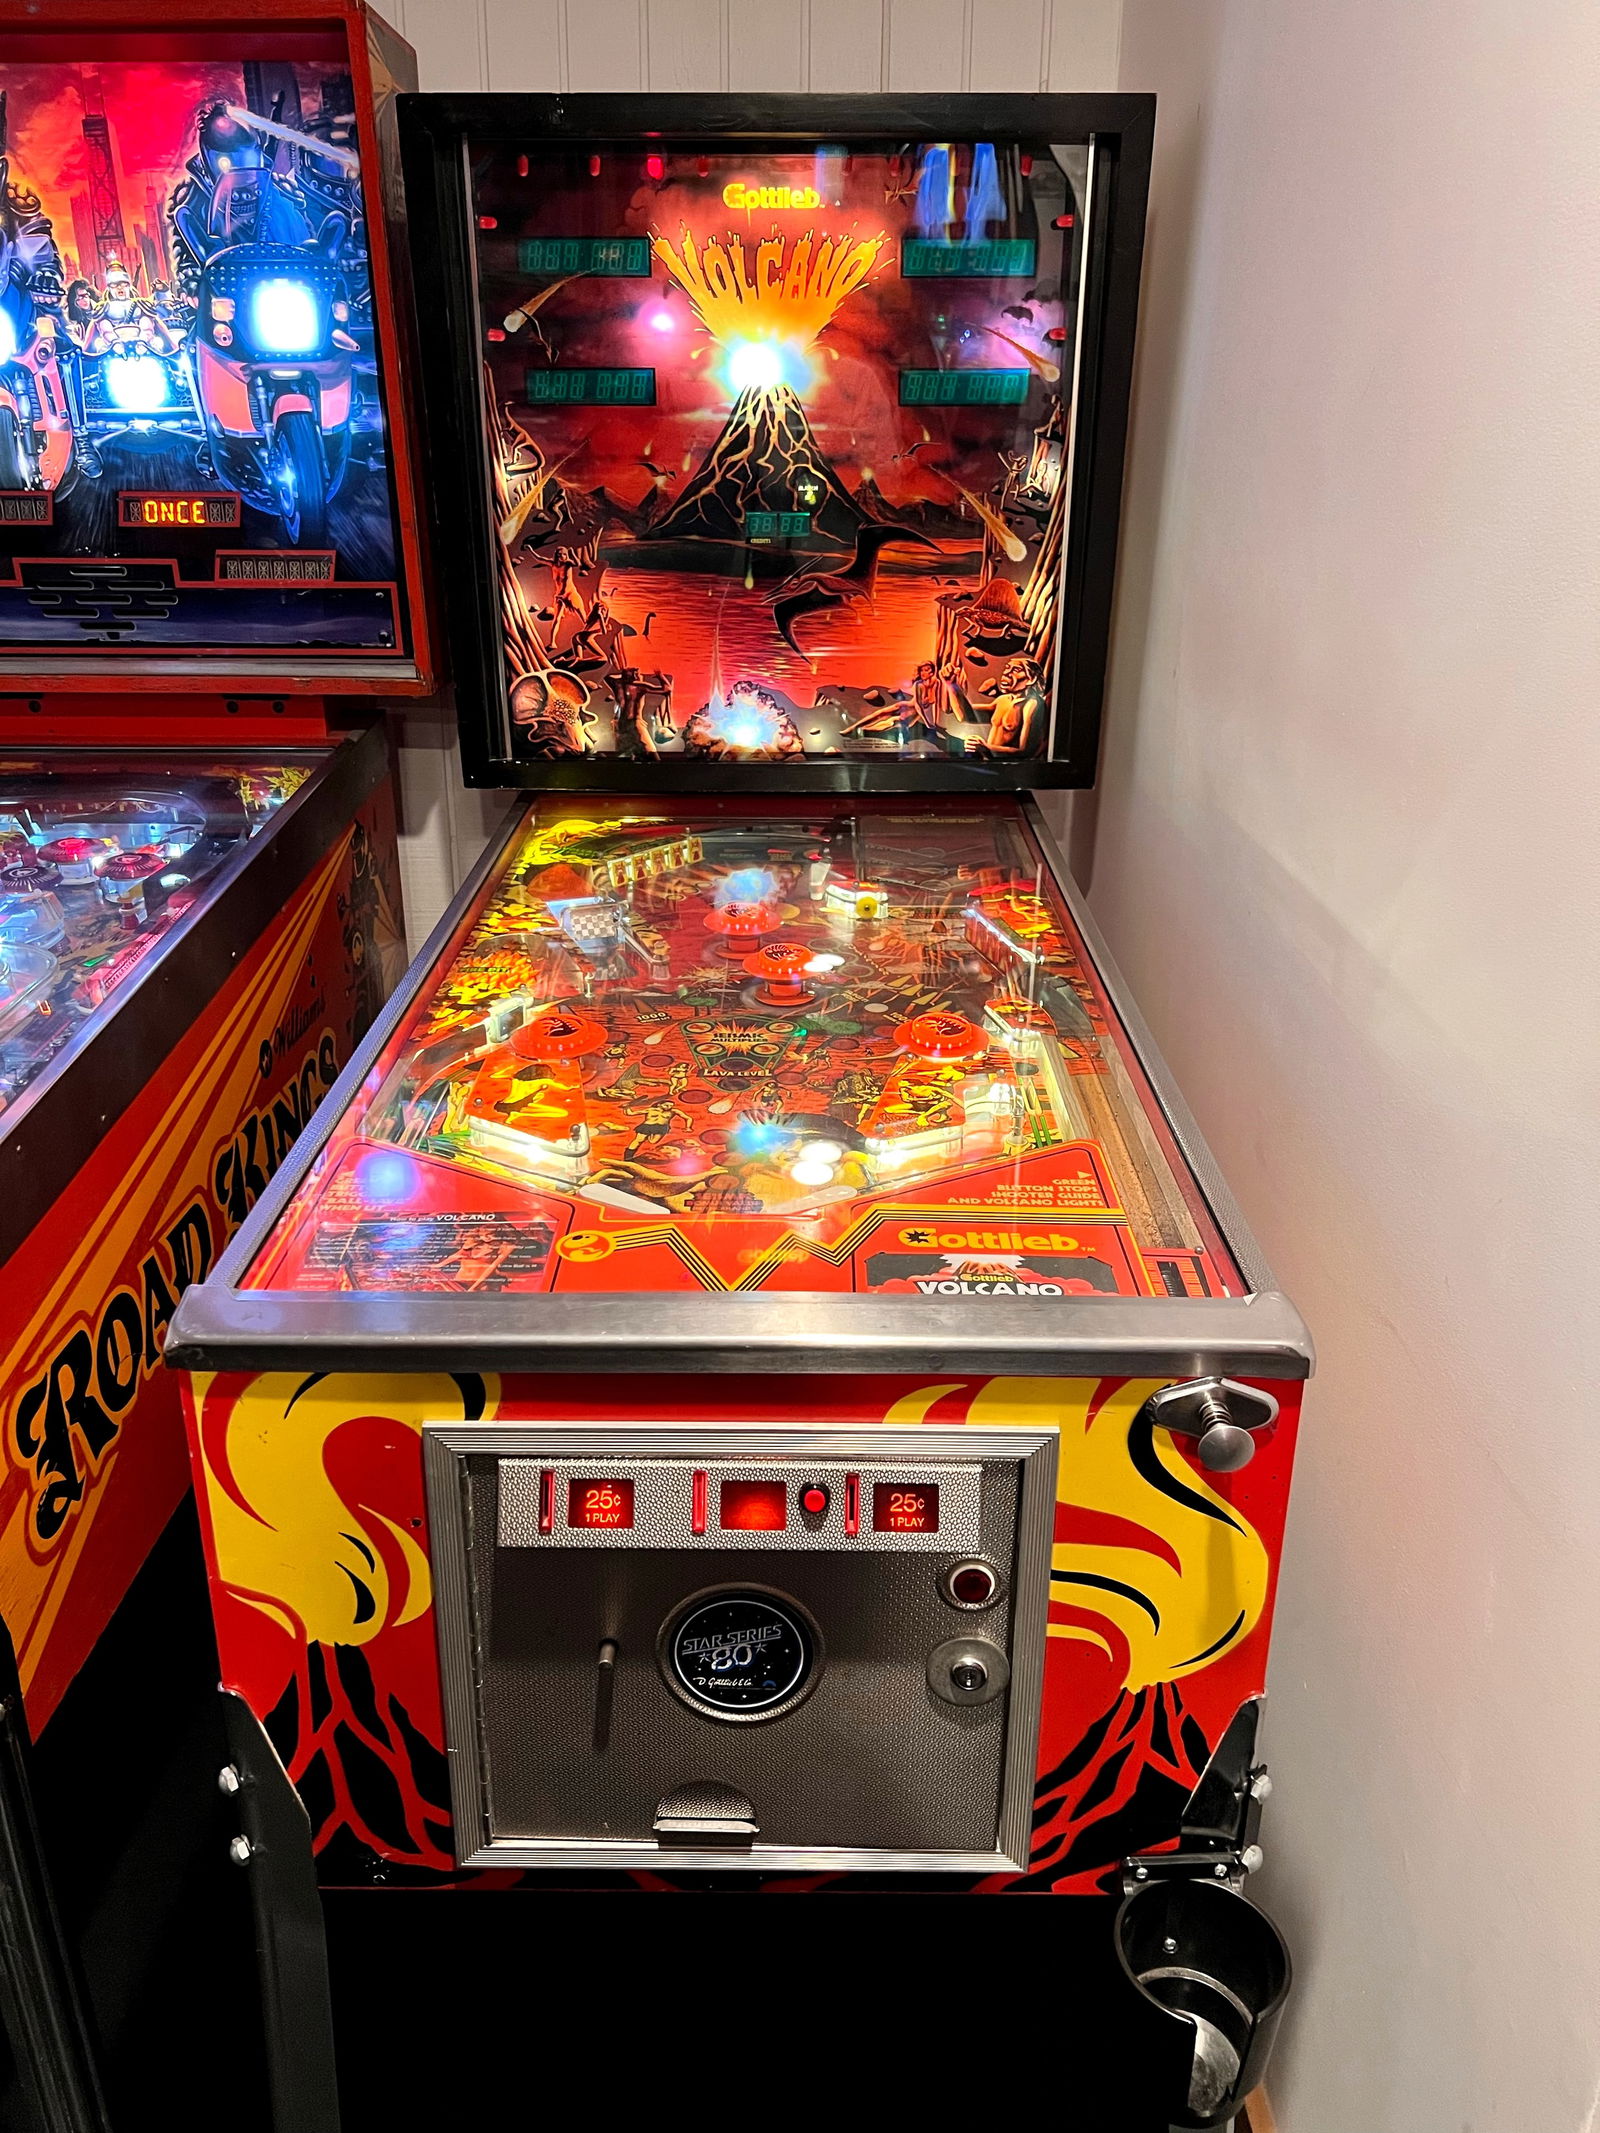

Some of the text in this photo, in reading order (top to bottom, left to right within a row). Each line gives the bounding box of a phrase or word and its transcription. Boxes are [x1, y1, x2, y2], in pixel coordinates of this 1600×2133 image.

[723, 183, 820, 209] Gottlieb
[651, 229, 885, 304] VOLCANO
[144, 500, 206, 524] ONCE
[635, 1012, 666, 1021] 1000
[703, 1068, 773, 1077] LAVA LEVEL
[997, 1184, 1098, 1193] BUTTON STOPS
[1057, 1192, 1100, 1200] GUIDE
[947, 1197, 1104, 1207] AND VOLCANO LIGHTS
[436, 1213, 496, 1222] VOLCANO
[898, 1227, 1079, 1251] Gottlieb
[959, 1273, 1014, 1283] Gottlieb
[15, 1034, 340, 1540] ROAD KINGS
[916, 1281, 1063, 1296] VOLCANO
[585, 1489, 621, 1509] 25¢
[889, 1492, 925, 1512] 25¢
[585, 1513, 621, 1523] 1 PLAY
[889, 1516, 925, 1527] 1 PLAY
[682, 1624, 783, 1654] STAR SERIES
[710, 1644, 753, 1671] 80
